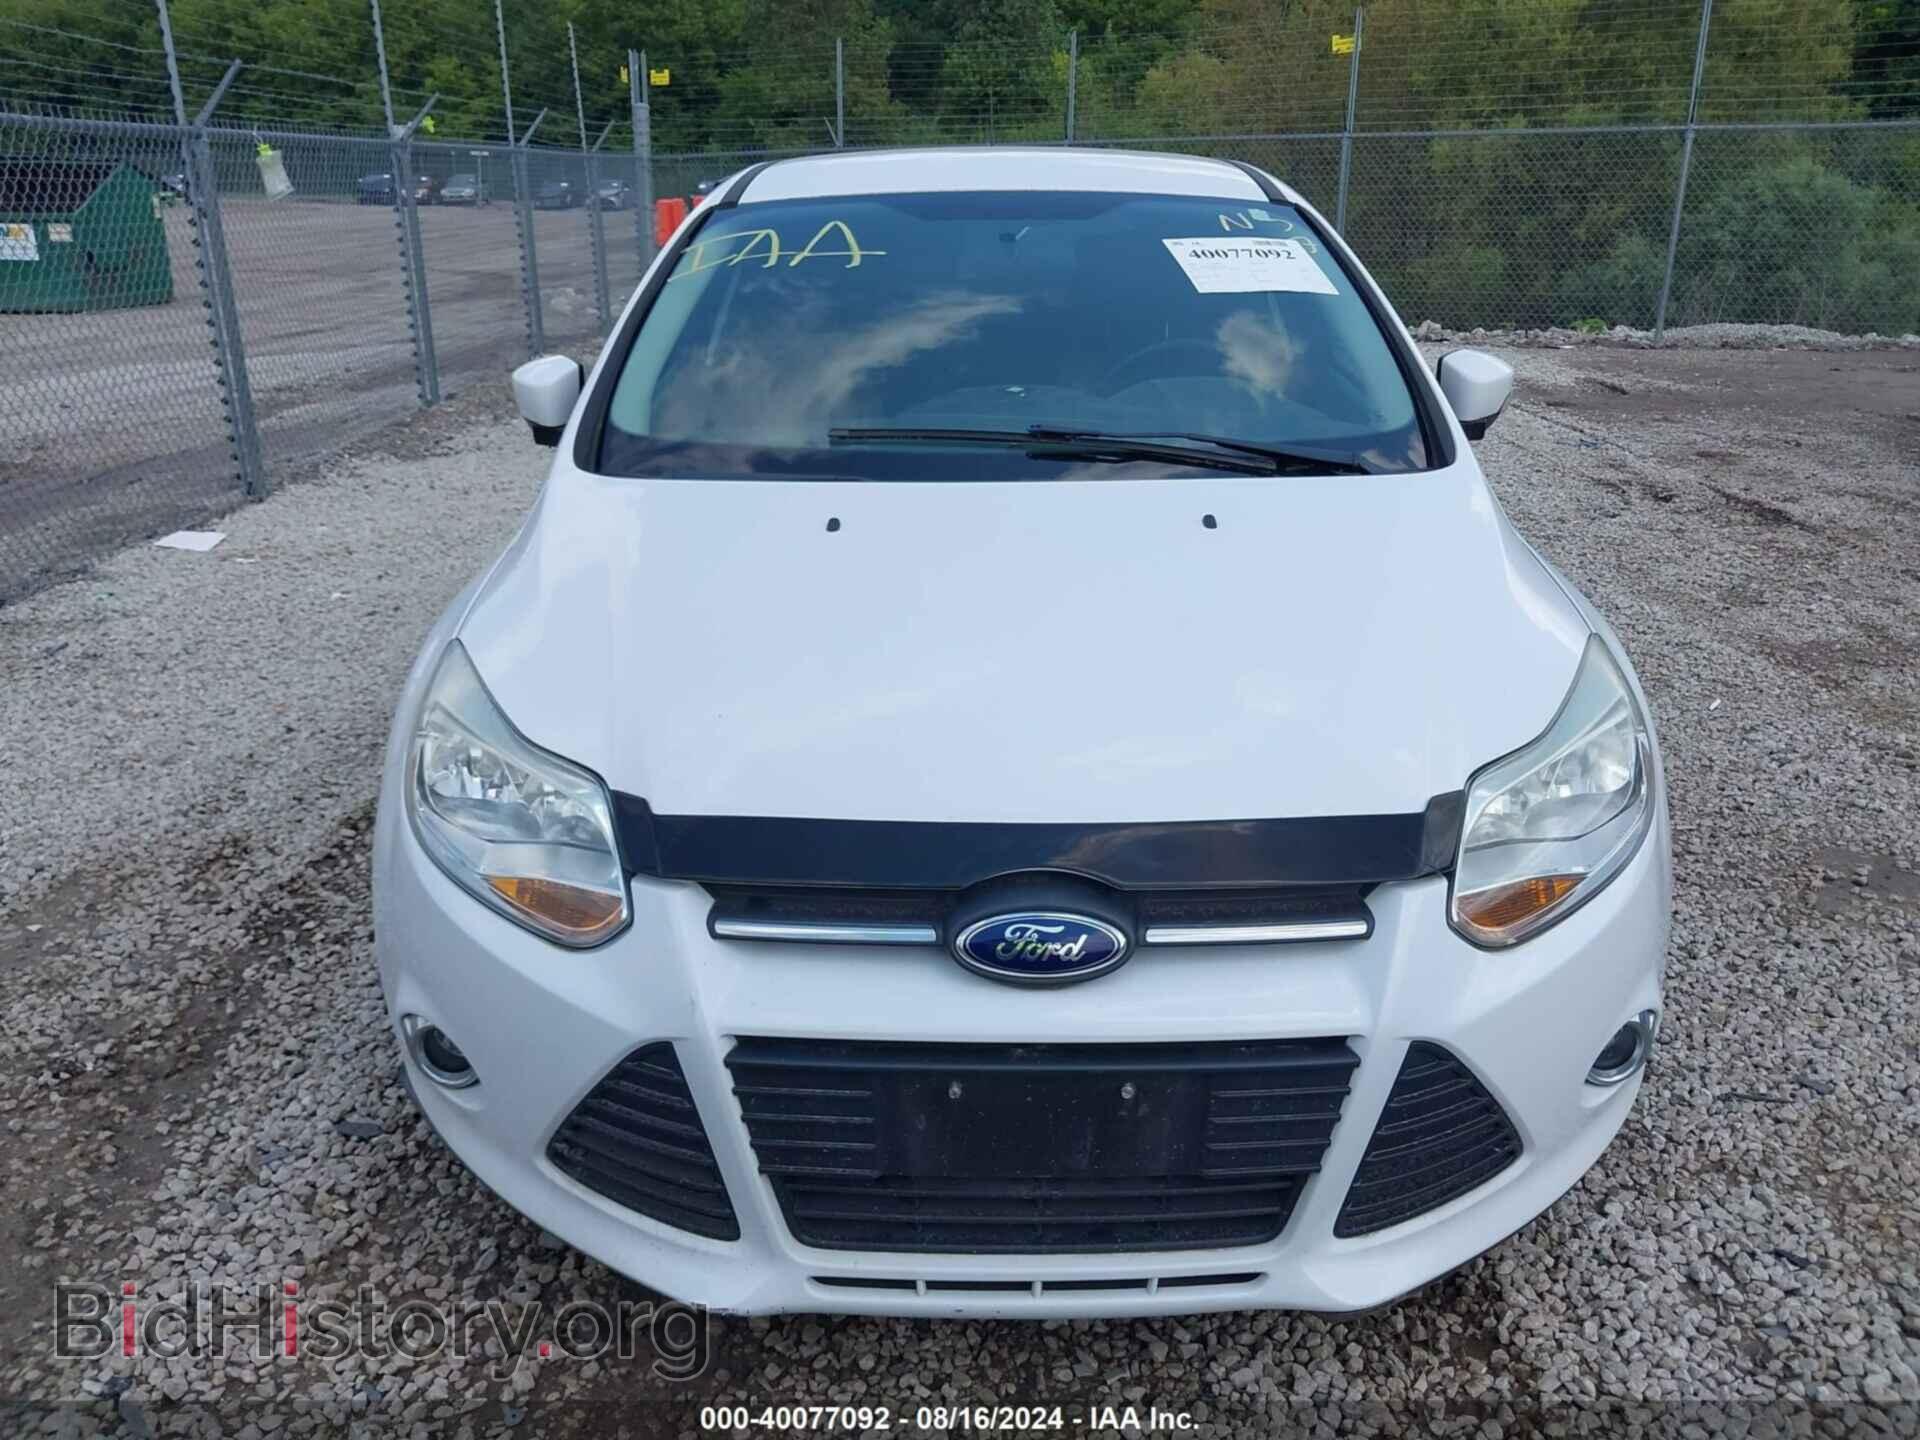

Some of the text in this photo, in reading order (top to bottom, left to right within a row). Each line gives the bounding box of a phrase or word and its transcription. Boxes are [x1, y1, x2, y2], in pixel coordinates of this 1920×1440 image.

[667, 220, 887, 283] IAA
[1188, 247, 1297, 260] 40077092
[995, 923, 1089, 962] Ford
